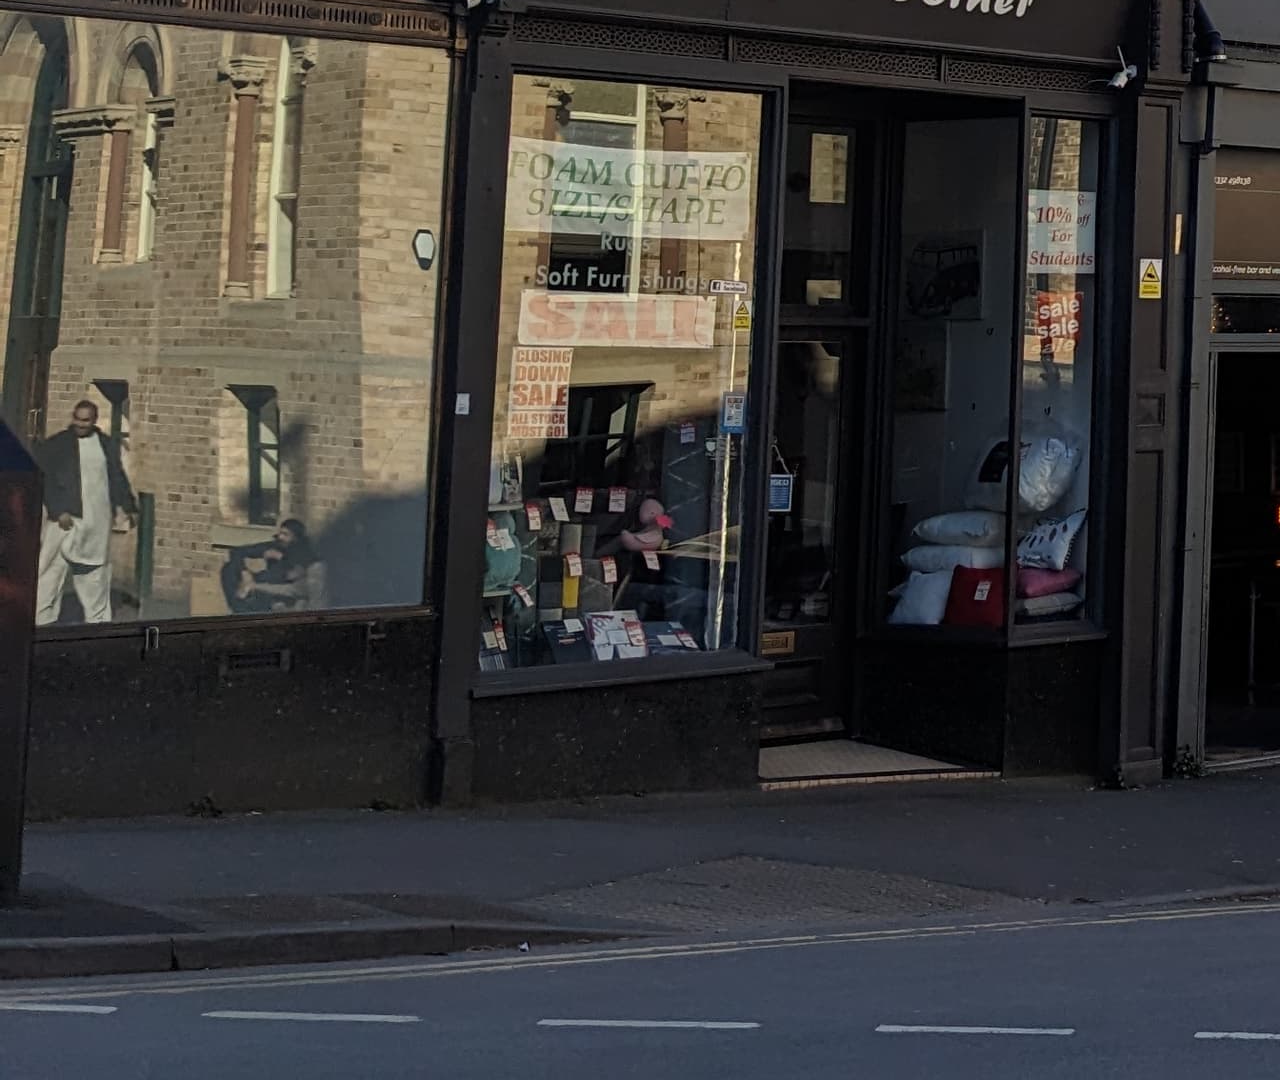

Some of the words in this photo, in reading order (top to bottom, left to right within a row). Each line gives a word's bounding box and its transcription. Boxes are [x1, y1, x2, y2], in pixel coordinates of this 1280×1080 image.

[511, 151, 613, 187] FOAM
[625, 162, 696, 190] CUT
[703, 164, 746, 191] TO
[527, 188, 726, 225] SIZE/SHAPE
[1036, 207, 1071, 224] 10%
[1077, 215, 1090, 227] off
[601, 232, 650, 257] Rugs
[1052, 230, 1072, 242] For
[1030, 251, 1093, 265] Students
[536, 264, 578, 287] Soft
[1246, 264, 1258, 274] bar
[1259, 266, 1272, 274] and
[1040, 297, 1080, 319] sale
[527, 294, 710, 345] SALE
[1038, 318, 1079, 339] sale
[1031, 338, 1075, 354] sale
[516, 350, 570, 363] CLOSING
[516, 365, 569, 382] DOWN
[513, 384, 567, 406] SALE
[511, 413, 529, 424] ALL
[531, 413, 565, 424] STOCK
[511, 426, 544, 437] MUST
